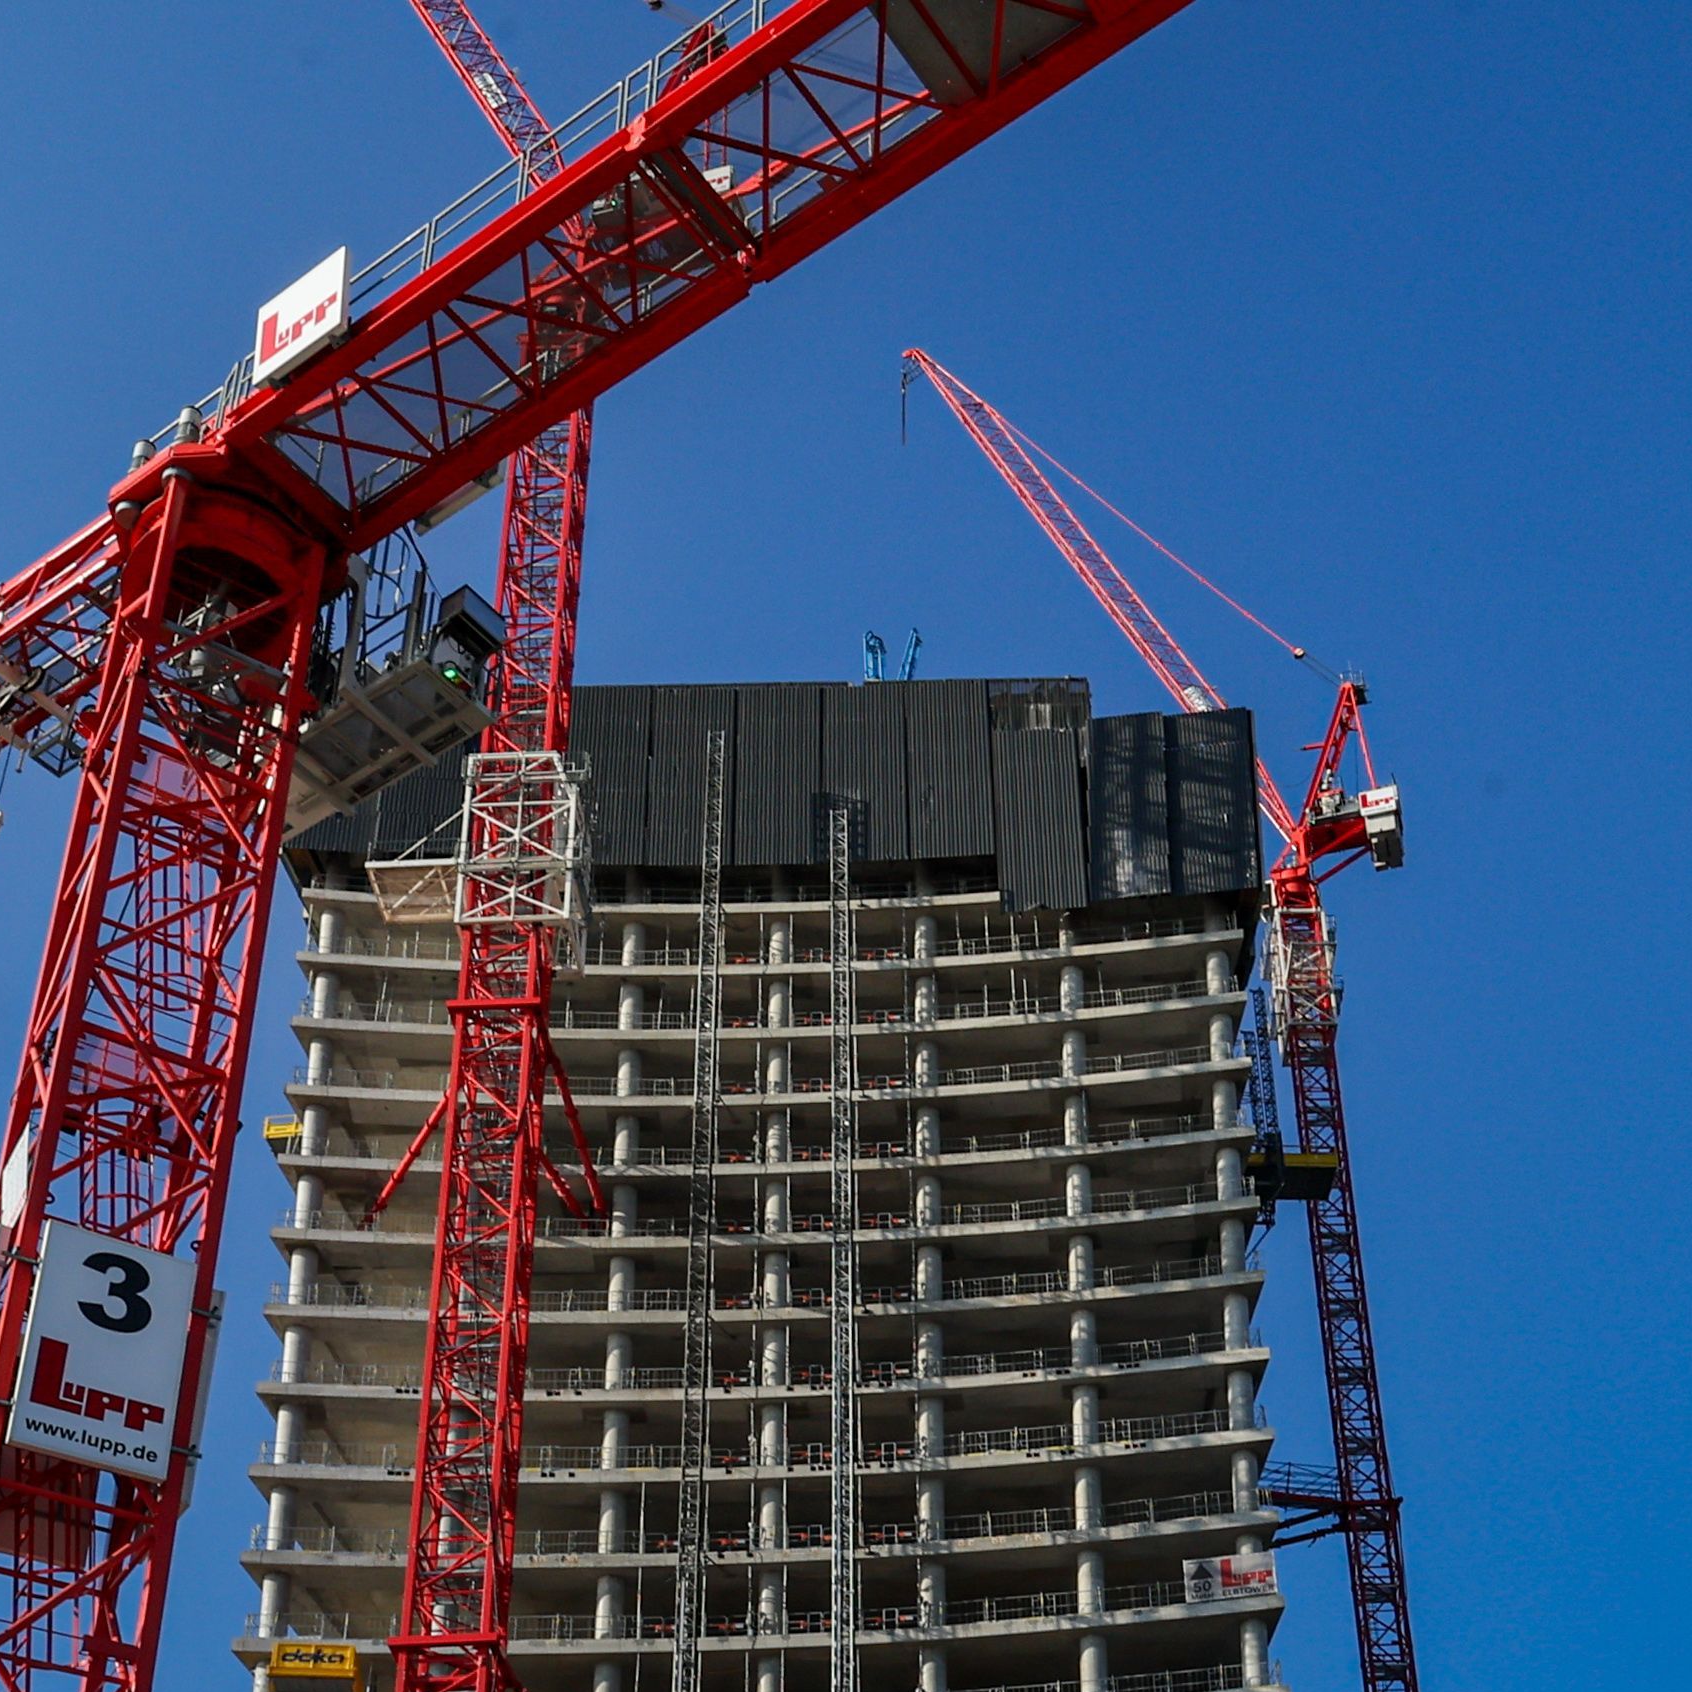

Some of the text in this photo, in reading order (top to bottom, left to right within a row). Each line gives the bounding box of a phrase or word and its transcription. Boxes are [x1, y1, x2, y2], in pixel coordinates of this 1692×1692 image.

[78, 1252, 152, 1333] 3
[25, 1417, 158, 1463] www.lupp.de
[1193, 1581, 1212, 1593] 50
[1222, 1585, 1275, 1597] ELBTOWER
